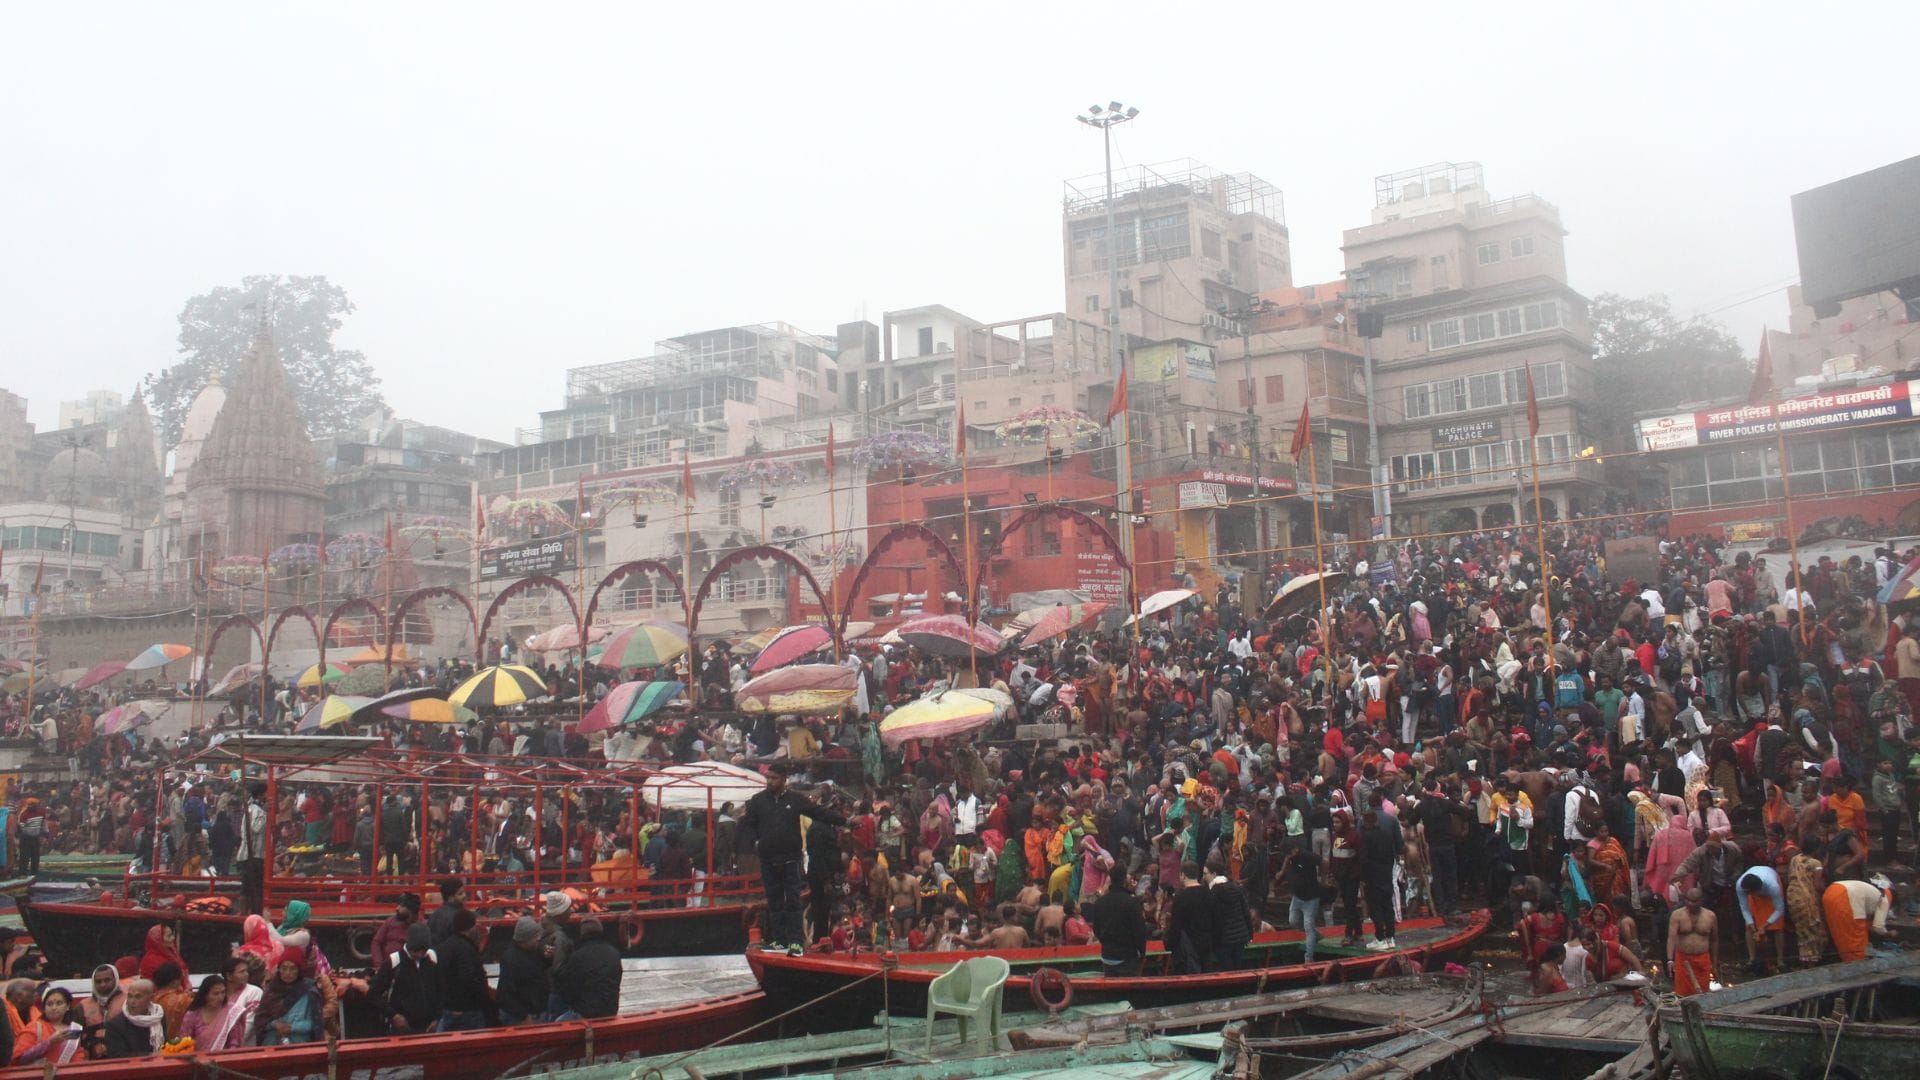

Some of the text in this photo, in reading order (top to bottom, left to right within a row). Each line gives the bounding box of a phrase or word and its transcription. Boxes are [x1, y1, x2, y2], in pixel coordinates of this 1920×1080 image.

[1734, 406, 1771, 424] पुलिस
[1835, 386, 1892, 405] वाराणसी
[1438, 422, 1493, 436] RAGHUNATH
[1709, 428, 1734, 440] RIVER
[1736, 424, 1765, 436] POLICE
[1851, 405, 1897, 420] VARANASI
[1448, 431, 1483, 442] PALACE
[1200, 483, 1225, 495] PANDEY
[500, 542, 563, 560] गंगा सेवा निधि
